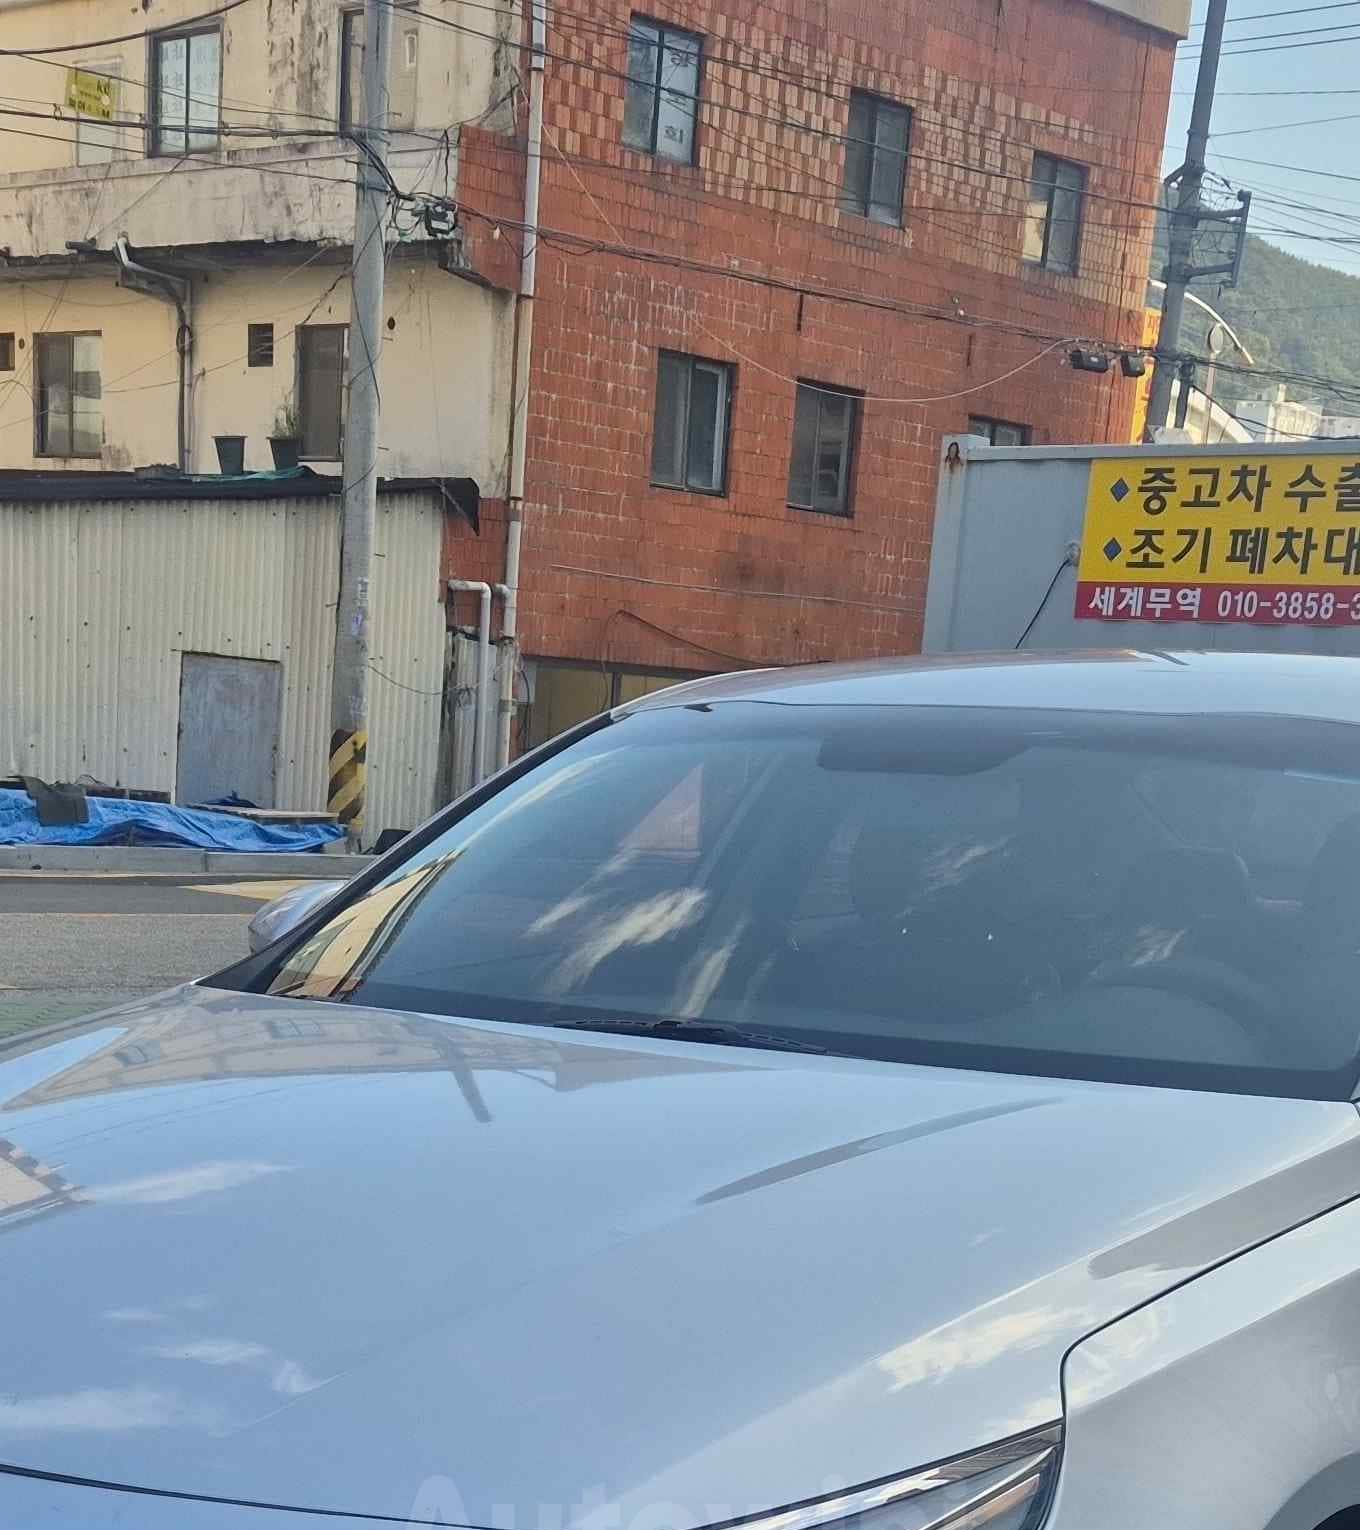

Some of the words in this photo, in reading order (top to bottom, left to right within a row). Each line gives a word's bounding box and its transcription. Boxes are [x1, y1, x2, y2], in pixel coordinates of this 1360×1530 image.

[1136, 463, 1272, 516] 중고차
[1125, 526, 1213, 574] 조기
[1088, 586, 1202, 619] 세계무역
